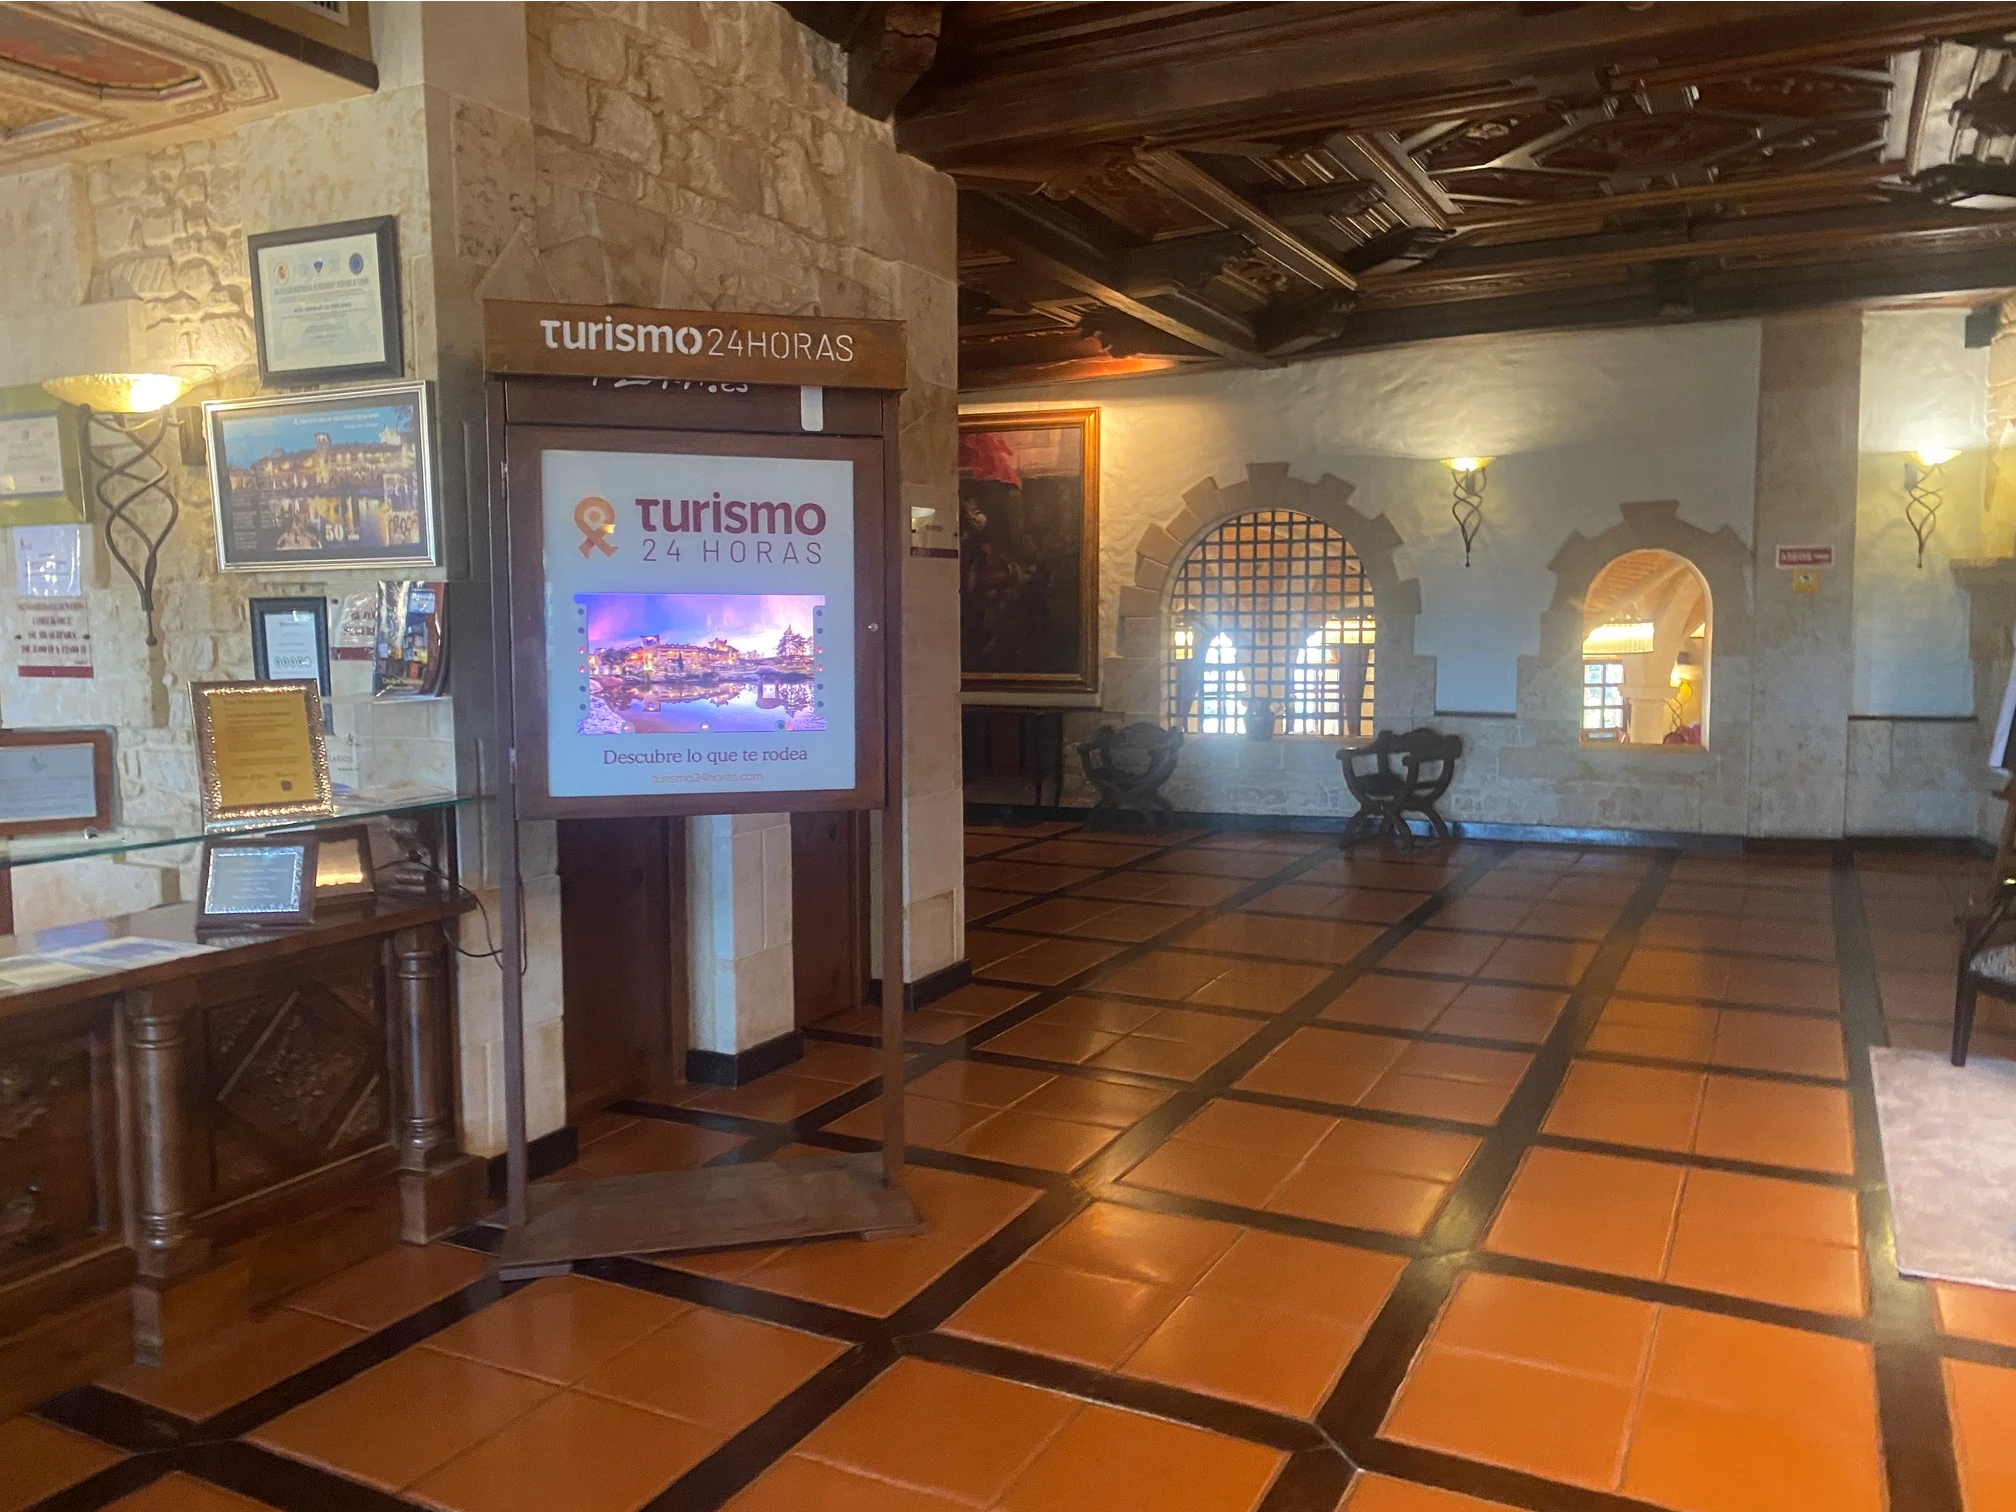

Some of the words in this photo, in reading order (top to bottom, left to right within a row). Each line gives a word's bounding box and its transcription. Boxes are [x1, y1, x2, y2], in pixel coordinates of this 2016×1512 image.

[540, 316, 703, 355] turismo
[635, 491, 827, 536] turismo
[325, 523, 344, 541] 50
[642, 538, 681, 562] 24
[703, 540, 822, 565] HORAS
[603, 749, 682, 764] Descubre
[687, 749, 702, 763] lo
[706, 751, 738, 765] que
[743, 749, 758, 761] te
[763, 747, 808, 761] rodea
